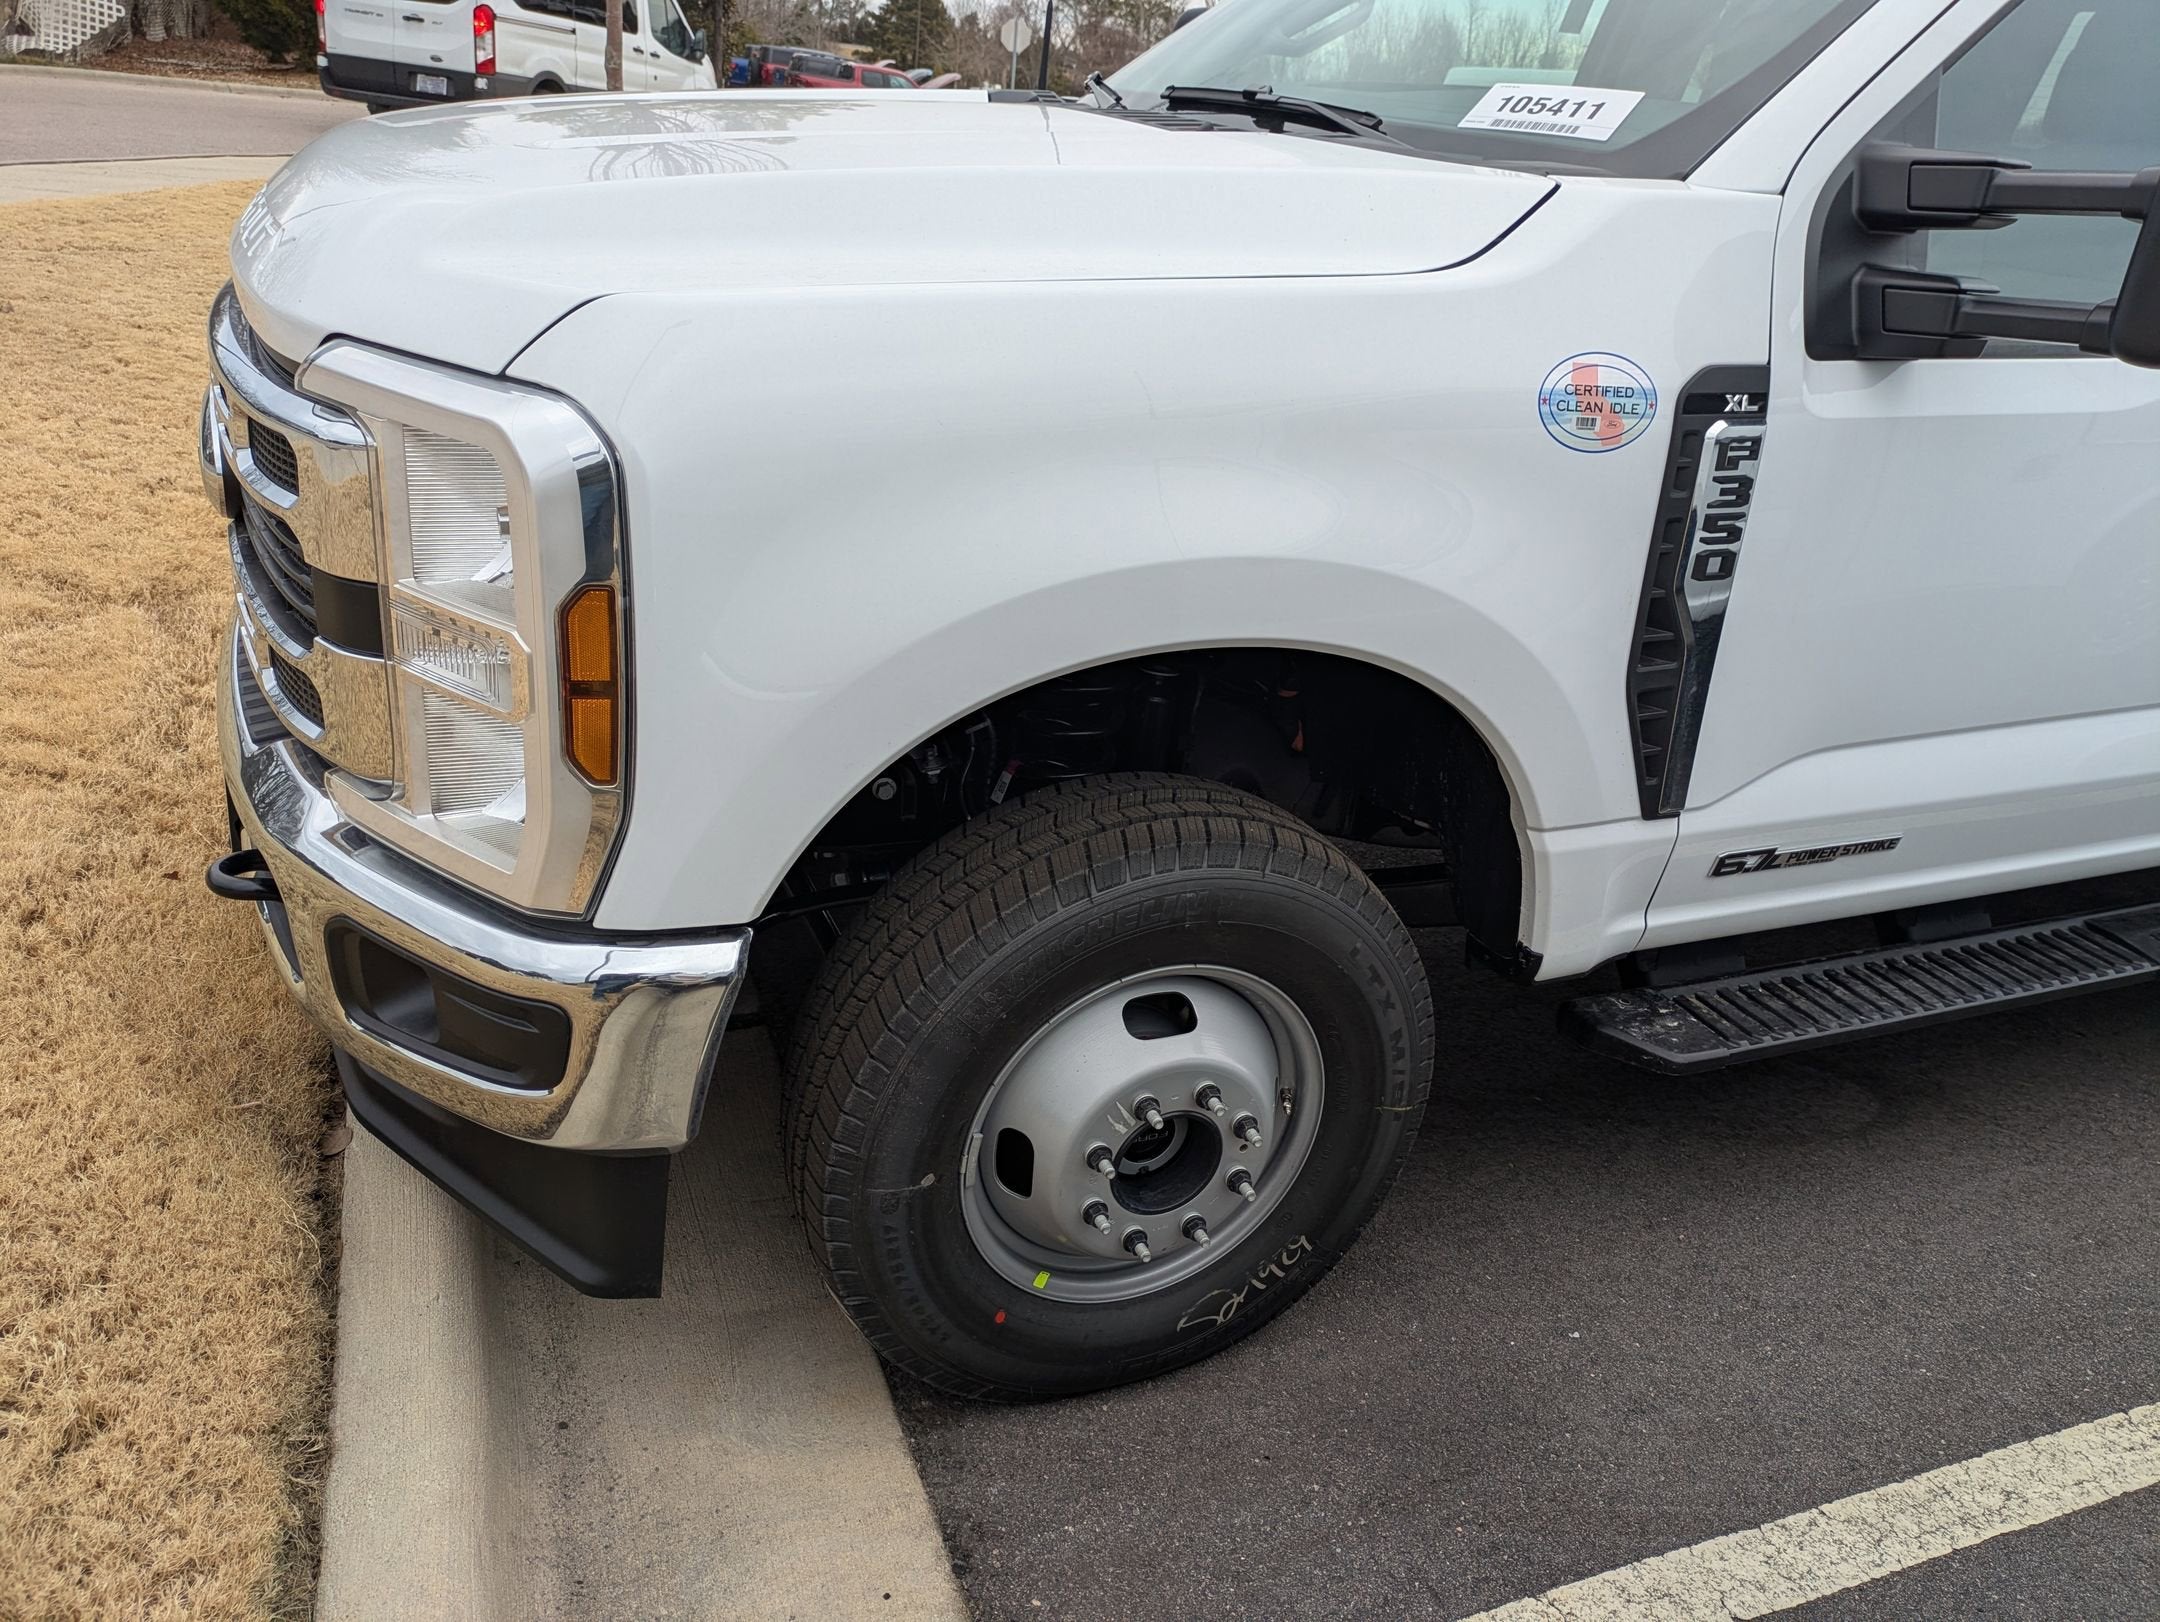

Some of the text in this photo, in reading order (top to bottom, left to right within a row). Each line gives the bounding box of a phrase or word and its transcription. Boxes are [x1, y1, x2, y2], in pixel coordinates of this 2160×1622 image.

[1496, 95, 1607, 121] 105411
[1564, 383, 1634, 398] CERTIFIED
[1556, 399, 1640, 415] CLEAN IDLE
[1723, 394, 1759, 412] XL
[1690, 436, 1762, 582] F350
[1786, 845, 1841, 863] POWER
[1840, 838, 1898, 856] STROKE
